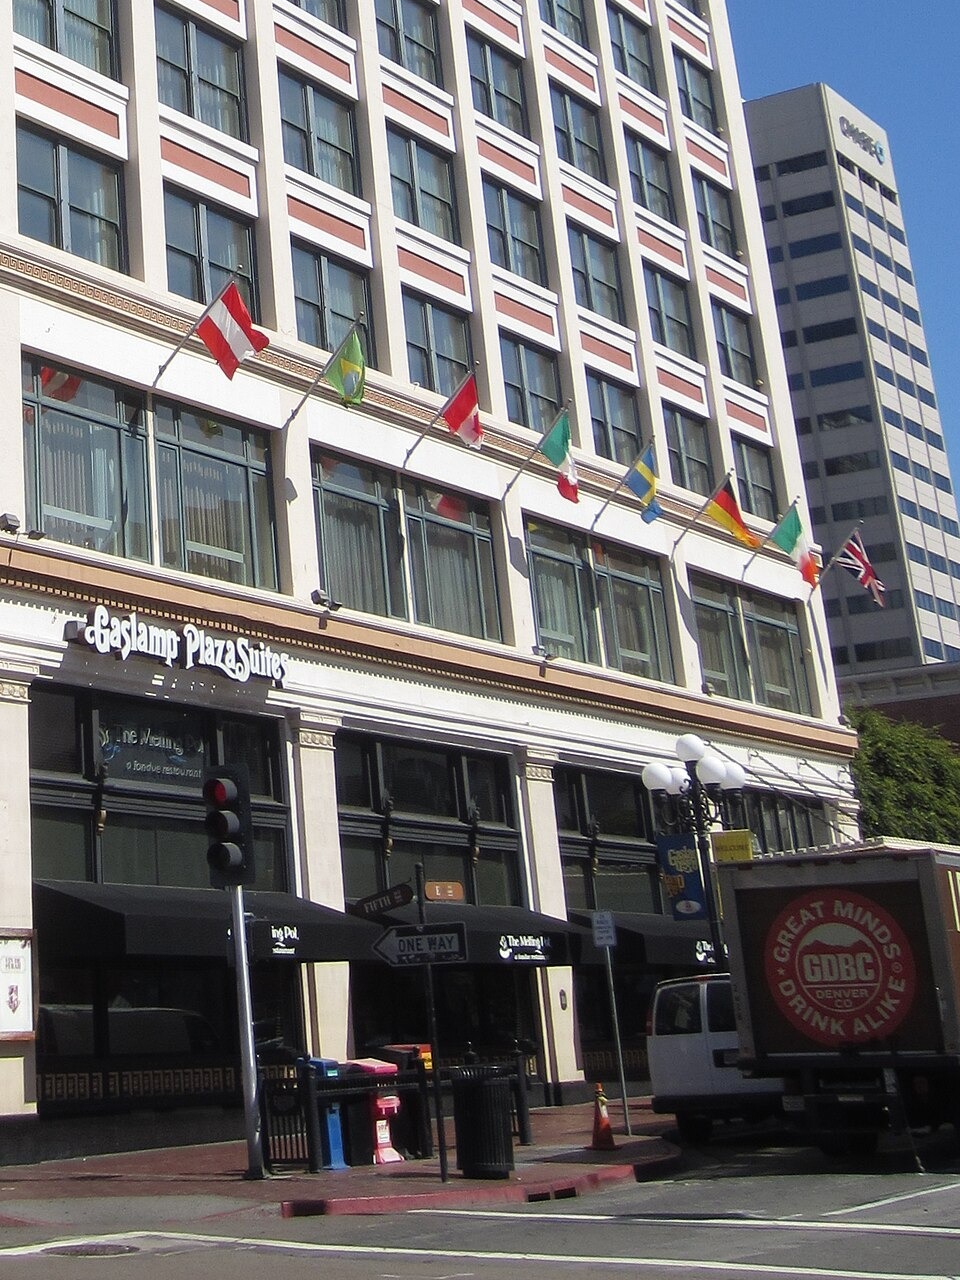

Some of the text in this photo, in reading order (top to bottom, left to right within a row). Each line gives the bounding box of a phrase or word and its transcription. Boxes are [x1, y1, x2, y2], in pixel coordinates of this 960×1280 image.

[84, 604, 290, 683] Gaslamp Plaza Suites
[114, 727, 137, 744] he
[126, 760, 202, 778] a fondue restaurant
[435, 885, 441, 897] E
[363, 895, 392, 914] FIFTH
[506, 934, 520, 947] The
[773, 900, 825, 964] GREAT
[833, 899, 902, 961] MINDS
[398, 935, 455, 953] ONE WAY
[802, 952, 876, 982] GDBC
[815, 988, 870, 1000] DENVER
[777, 978, 846, 1036] DRINK
[852, 975, 907, 1036] ALIKE
[833, 999, 853, 1009] CO
